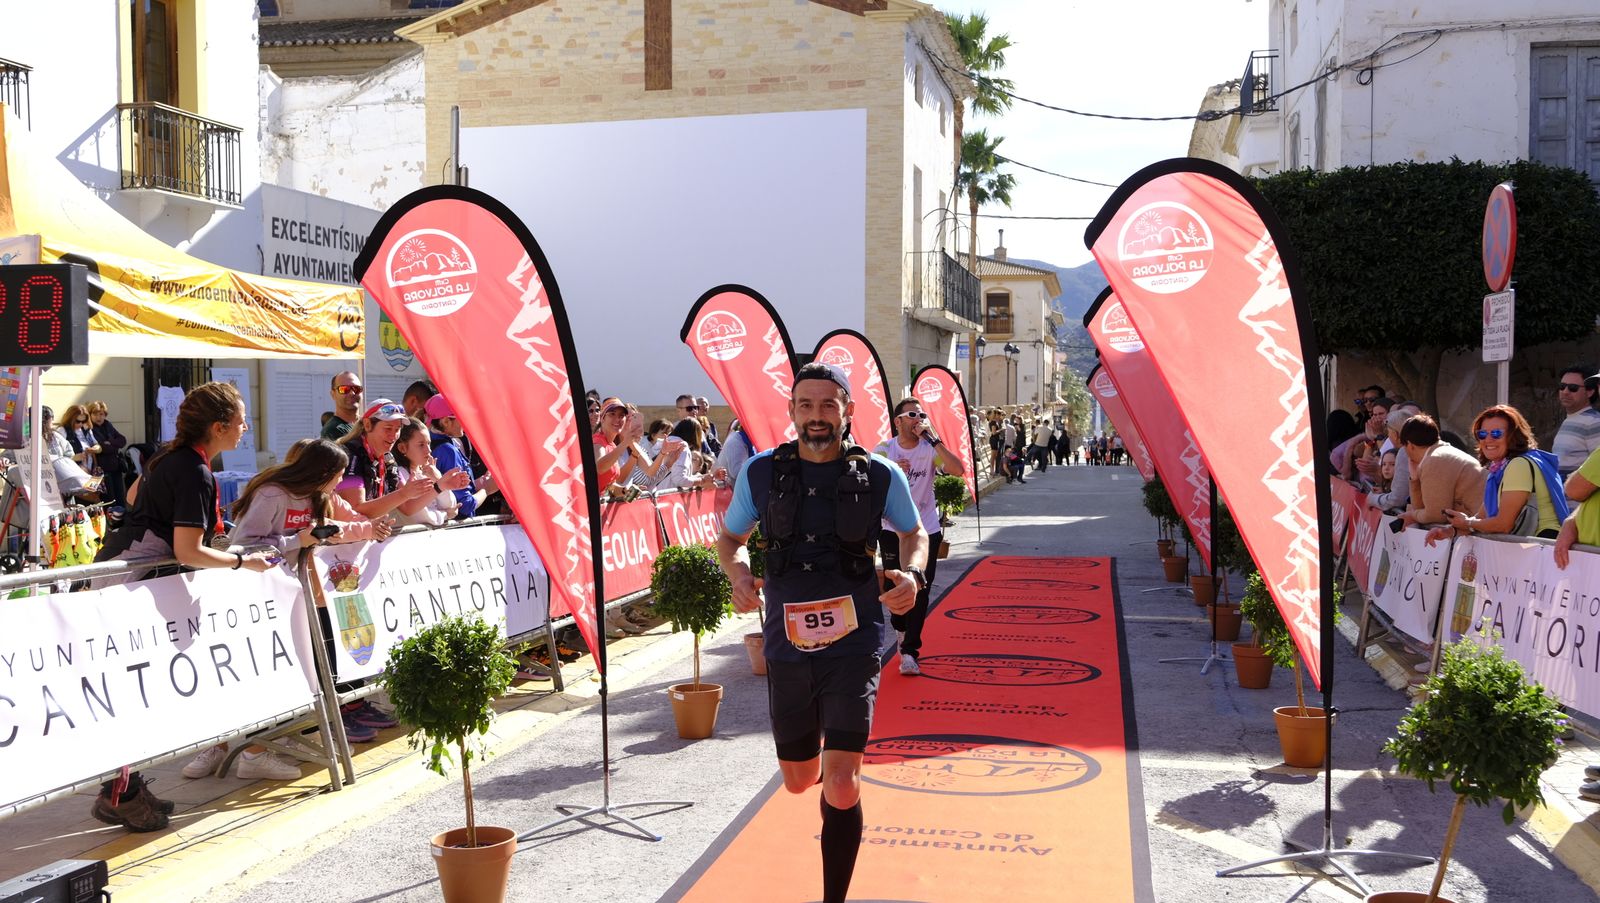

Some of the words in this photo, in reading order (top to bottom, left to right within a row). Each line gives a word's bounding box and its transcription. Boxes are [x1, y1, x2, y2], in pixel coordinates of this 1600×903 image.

[271, 217, 370, 253] EXCELENTÍSIM
[274, 252, 356, 284] AYUNTAMIEN
[602, 528, 652, 572] EOLIA
[379, 553, 505, 589] AYUNTAMIENTO
[511, 550, 529, 566] DE
[382, 570, 538, 633] CANTORIA
[804, 611, 835, 629] 95
[1474, 600, 1600, 673] CANTORI
[1, 608, 238, 678] YUNTAMIENTO
[249, 599, 277, 623] DE
[902, 705, 1069, 718] Ayuntamiento
[919, 700, 1019, 709] Cantoria
[876, 742, 1017, 758] POLVORA
[1029, 750, 1066, 758] LA
[863, 825, 983, 840] Cantori
[993, 832, 1034, 843] de
